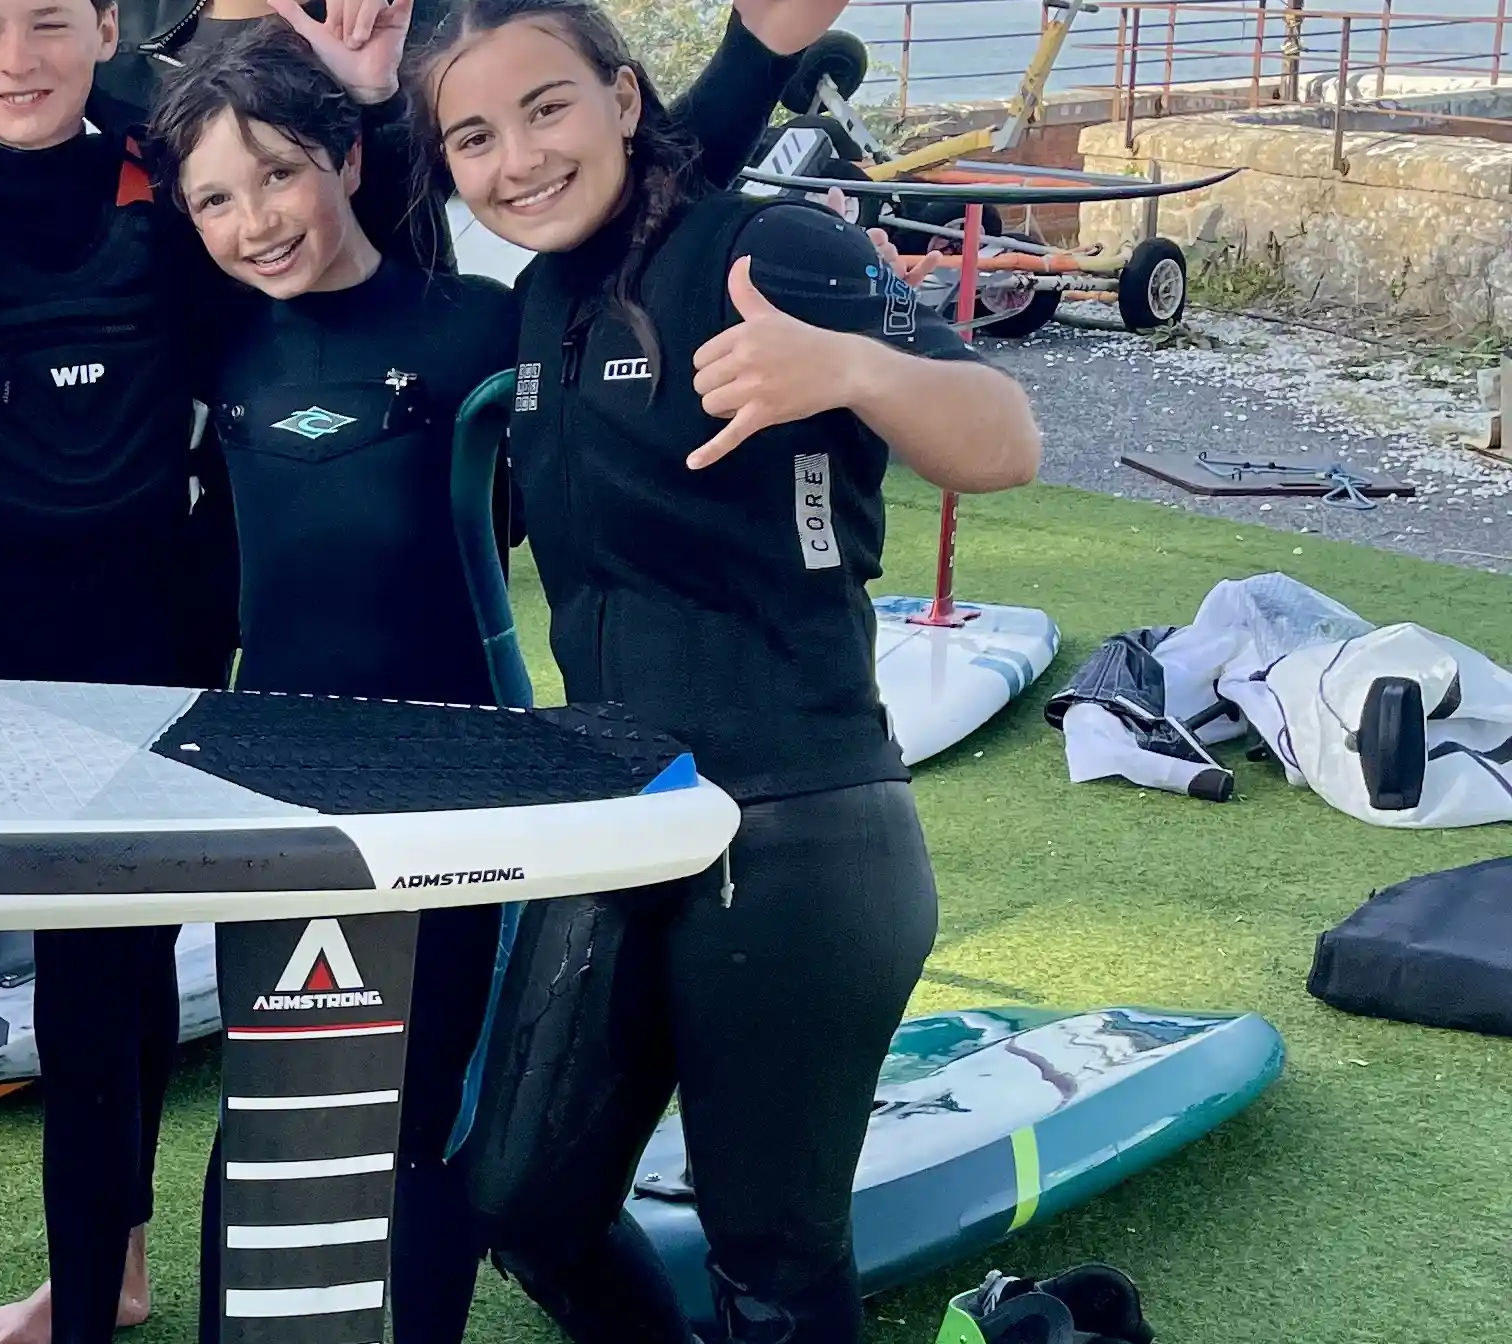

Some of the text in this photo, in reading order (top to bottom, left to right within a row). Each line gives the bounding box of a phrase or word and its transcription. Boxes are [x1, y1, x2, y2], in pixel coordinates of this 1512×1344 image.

[50, 362, 105, 388] WIP
[804, 469, 829, 552] CORE
[391, 867, 526, 890] ARMSTRONG
[252, 990, 384, 1011] ARMSTRONG
